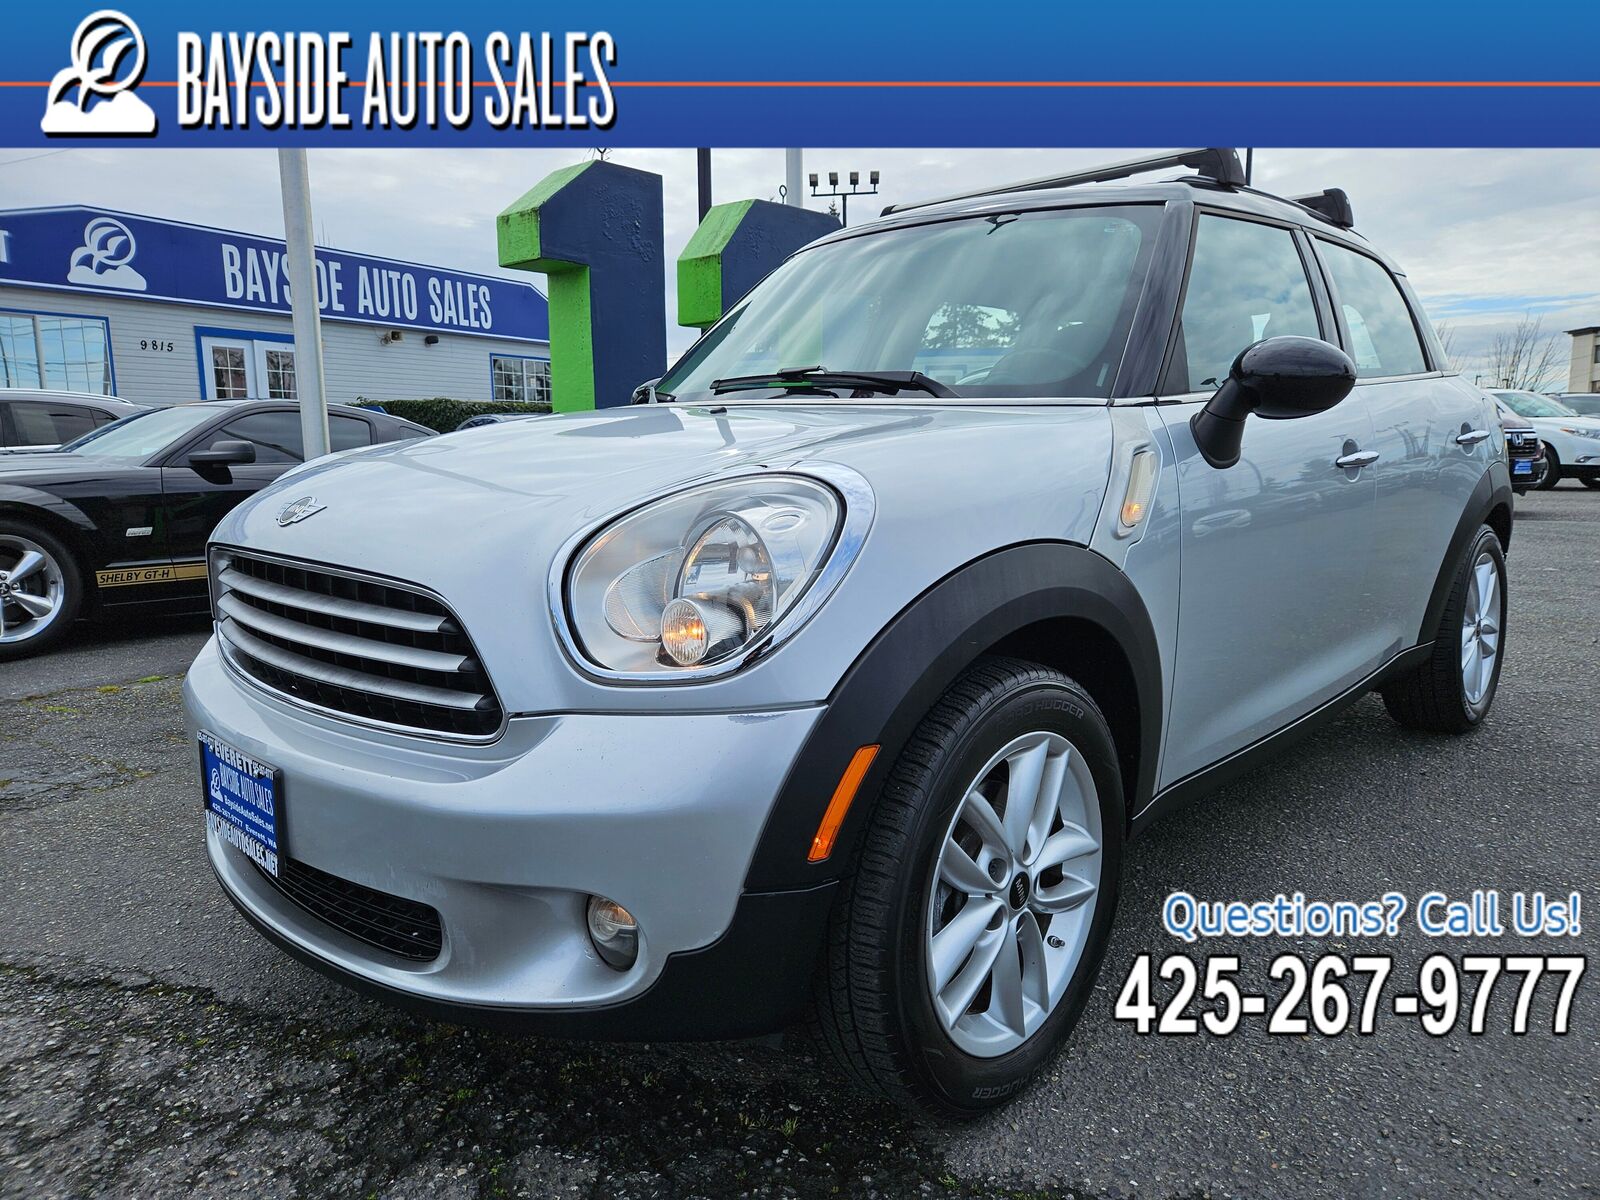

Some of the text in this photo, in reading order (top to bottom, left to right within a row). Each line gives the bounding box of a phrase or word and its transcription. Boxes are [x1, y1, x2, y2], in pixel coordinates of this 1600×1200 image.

[221, 243, 492, 330] BAYSDE AUTO SALES
[140, 339, 174, 352] 9815
[100, 569, 170, 583] SHELBY GT-H
[214, 740, 254, 777] EVERETT
[219, 762, 242, 798] BAYSIDE
[241, 774, 256, 806] AUTO
[254, 781, 275, 817] SALES
